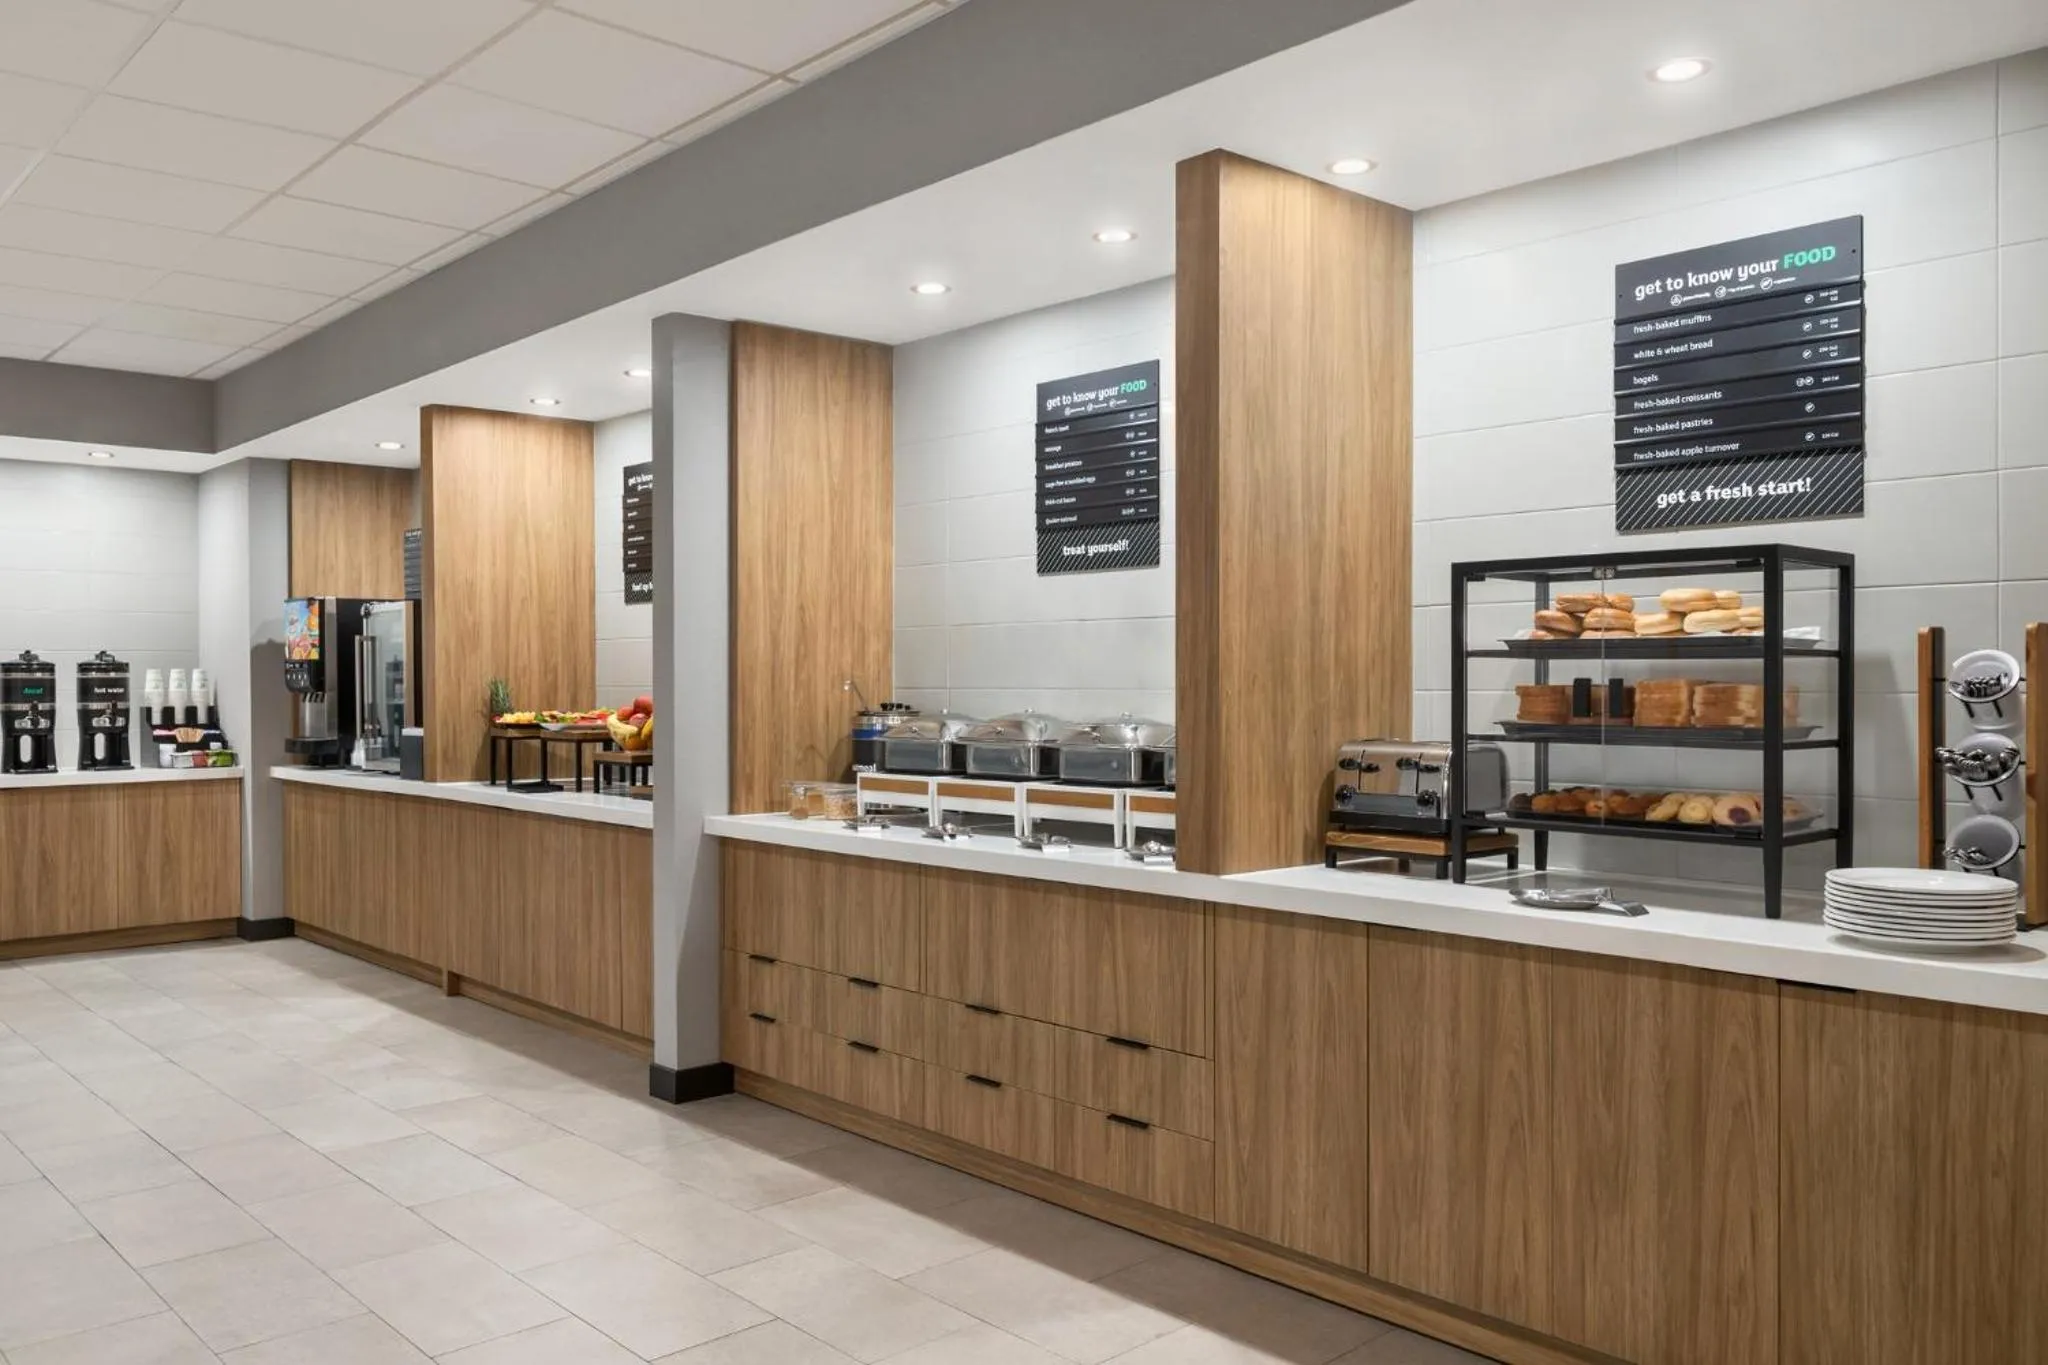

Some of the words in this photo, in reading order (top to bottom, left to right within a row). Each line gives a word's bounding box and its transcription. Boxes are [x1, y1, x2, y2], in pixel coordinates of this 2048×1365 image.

[1635, 280, 1663, 301] get
[1666, 277, 1684, 291] to
[1687, 267, 1735, 287] know
[1737, 259, 1780, 282] your
[1783, 245, 1836, 269] FOOD
[1633, 319, 1680, 334] fresh-baked
[1680, 314, 1713, 326] muffins
[1633, 349, 1655, 359] white
[1664, 343, 1689, 355] wheat
[1689, 338, 1713, 351] bread
[1633, 373, 1659, 385] bagels
[1046, 396, 1061, 411] get
[1062, 394, 1072, 405] to
[1073, 391, 1097, 403] know
[1098, 386, 1119, 401] your
[1120, 379, 1147, 393] FOOD
[1633, 395, 1680, 410] fresh-baked
[1681, 390, 1722, 404] croissants
[1633, 421, 1680, 435] fresh-baked
[1681, 418, 1713, 431] pastries
[1633, 447, 1680, 461] fresh-baked
[1681, 444, 1703, 457] apple
[1704, 442, 1739, 454] turnover
[1657, 489, 1686, 508] get
[1690, 491, 1702, 502] a
[1705, 482, 1754, 501] fresh
[1758, 477, 1812, 497] start!
[1063, 545, 1086, 556] treat
